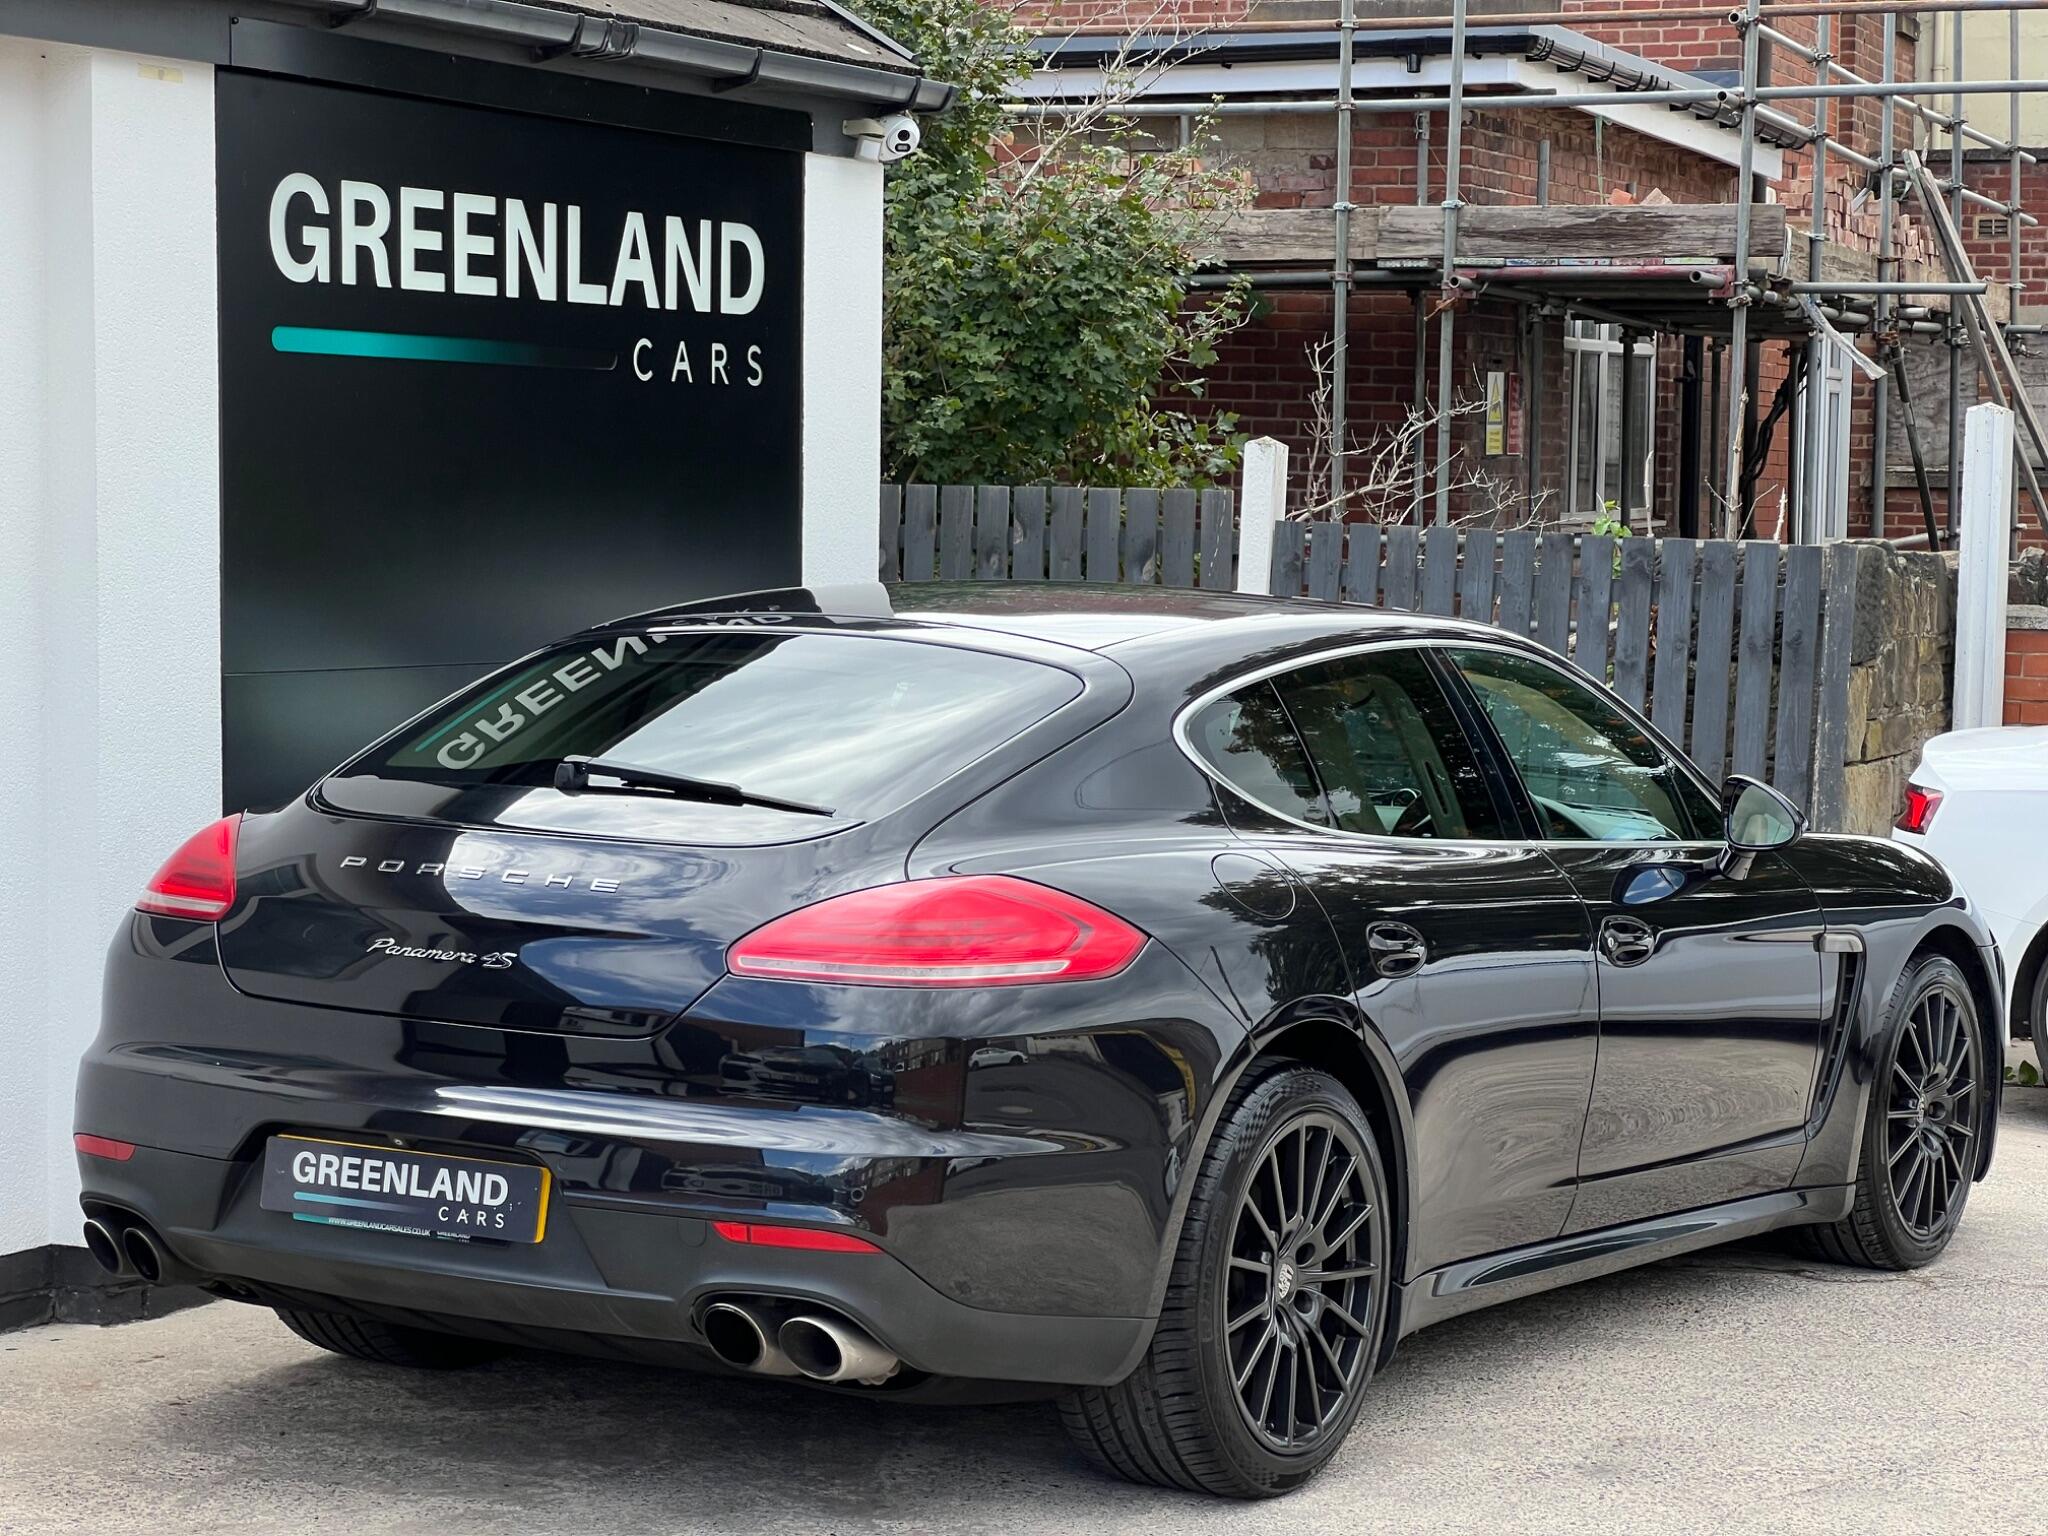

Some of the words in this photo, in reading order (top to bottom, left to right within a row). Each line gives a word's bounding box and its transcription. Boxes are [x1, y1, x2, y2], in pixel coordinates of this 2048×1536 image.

[269, 172, 765, 315] GREENLAND
[632, 337, 763, 387] CARS
[340, 855, 620, 893] PORSCHE
[366, 937, 477, 964] Panamera
[480, 951, 518, 969] 4S
[292, 1150, 509, 1207] GREENLAND
[438, 1206, 505, 1229] CARS
